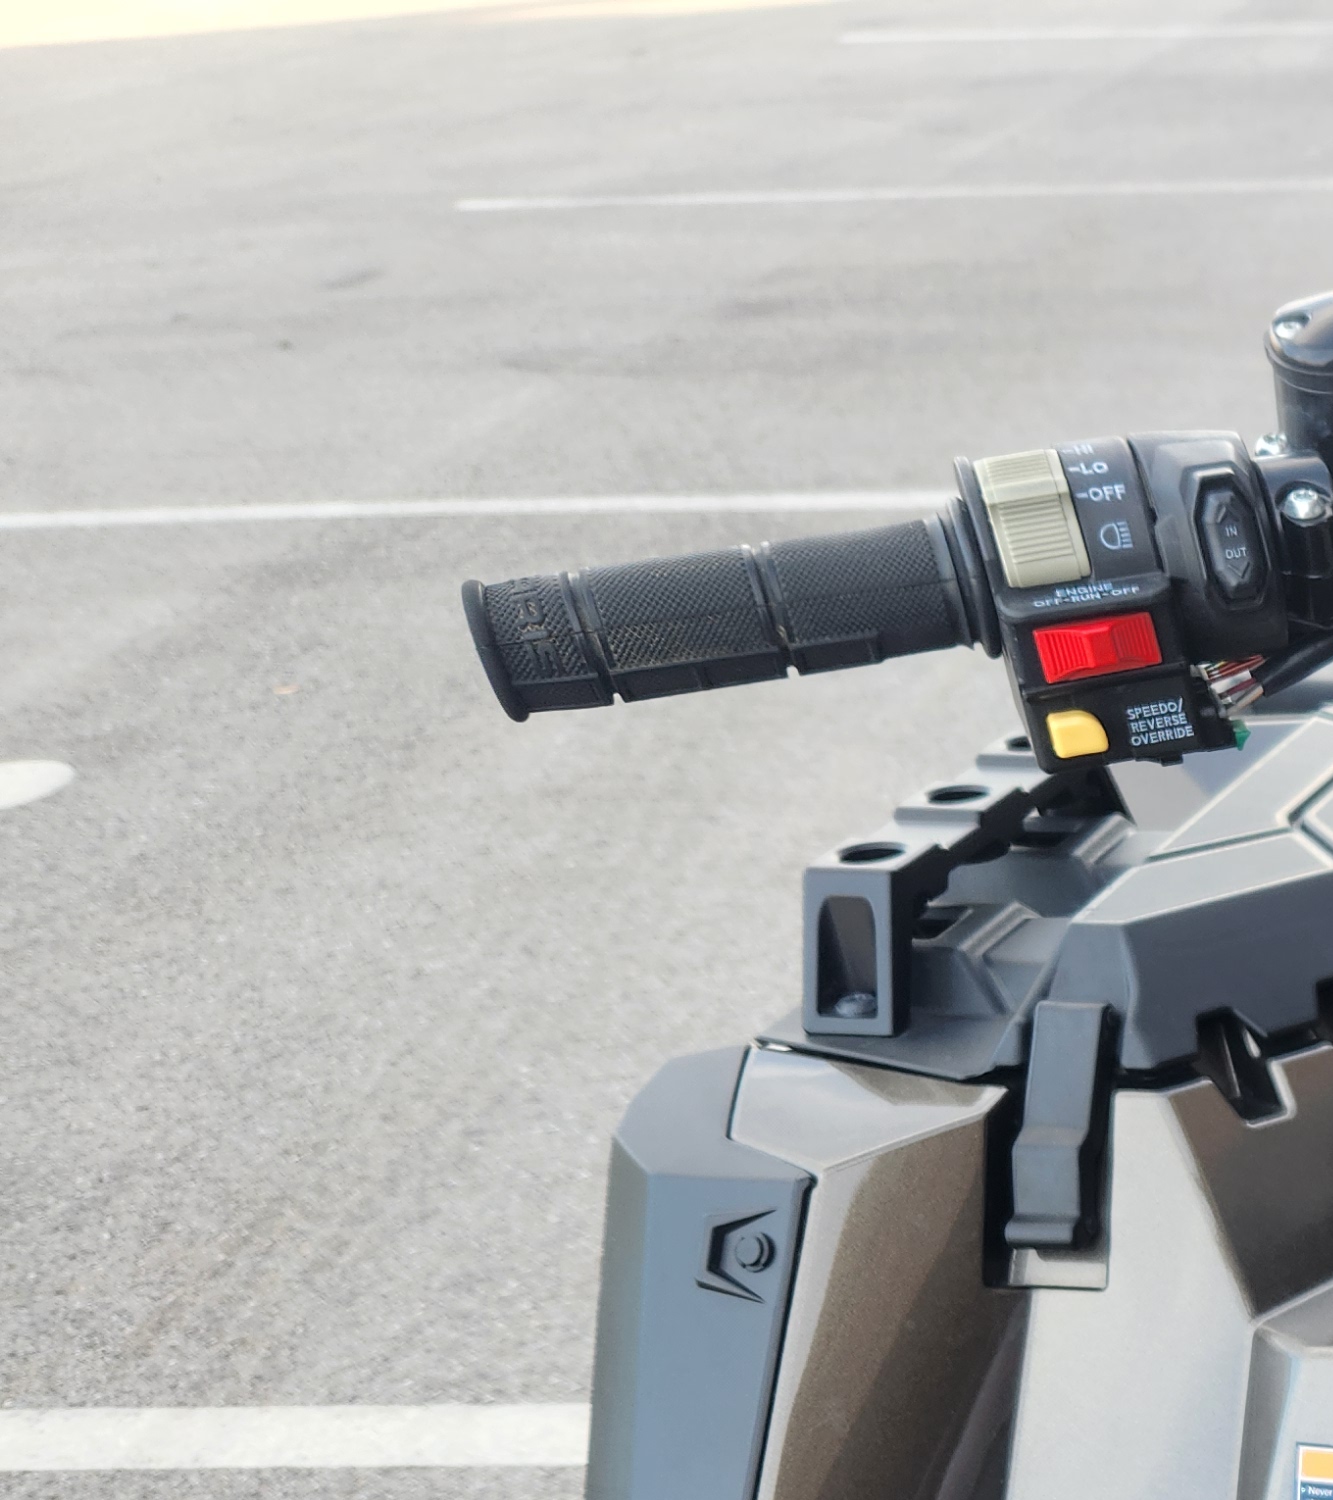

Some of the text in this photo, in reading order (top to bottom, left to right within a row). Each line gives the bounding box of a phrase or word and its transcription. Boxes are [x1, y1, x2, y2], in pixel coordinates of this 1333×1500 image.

[1225, 525, 1238, 537] IN
[1225, 546, 1246, 559] OUT
[1055, 582, 1113, 597] ENGINE
[1126, 697, 1183, 720] SPEEDO/
[1130, 713, 1188, 733] REVERSE
[1130, 725, 1195, 746] OVERRIDE
[1308, 1486, 1332, 1496] Never
